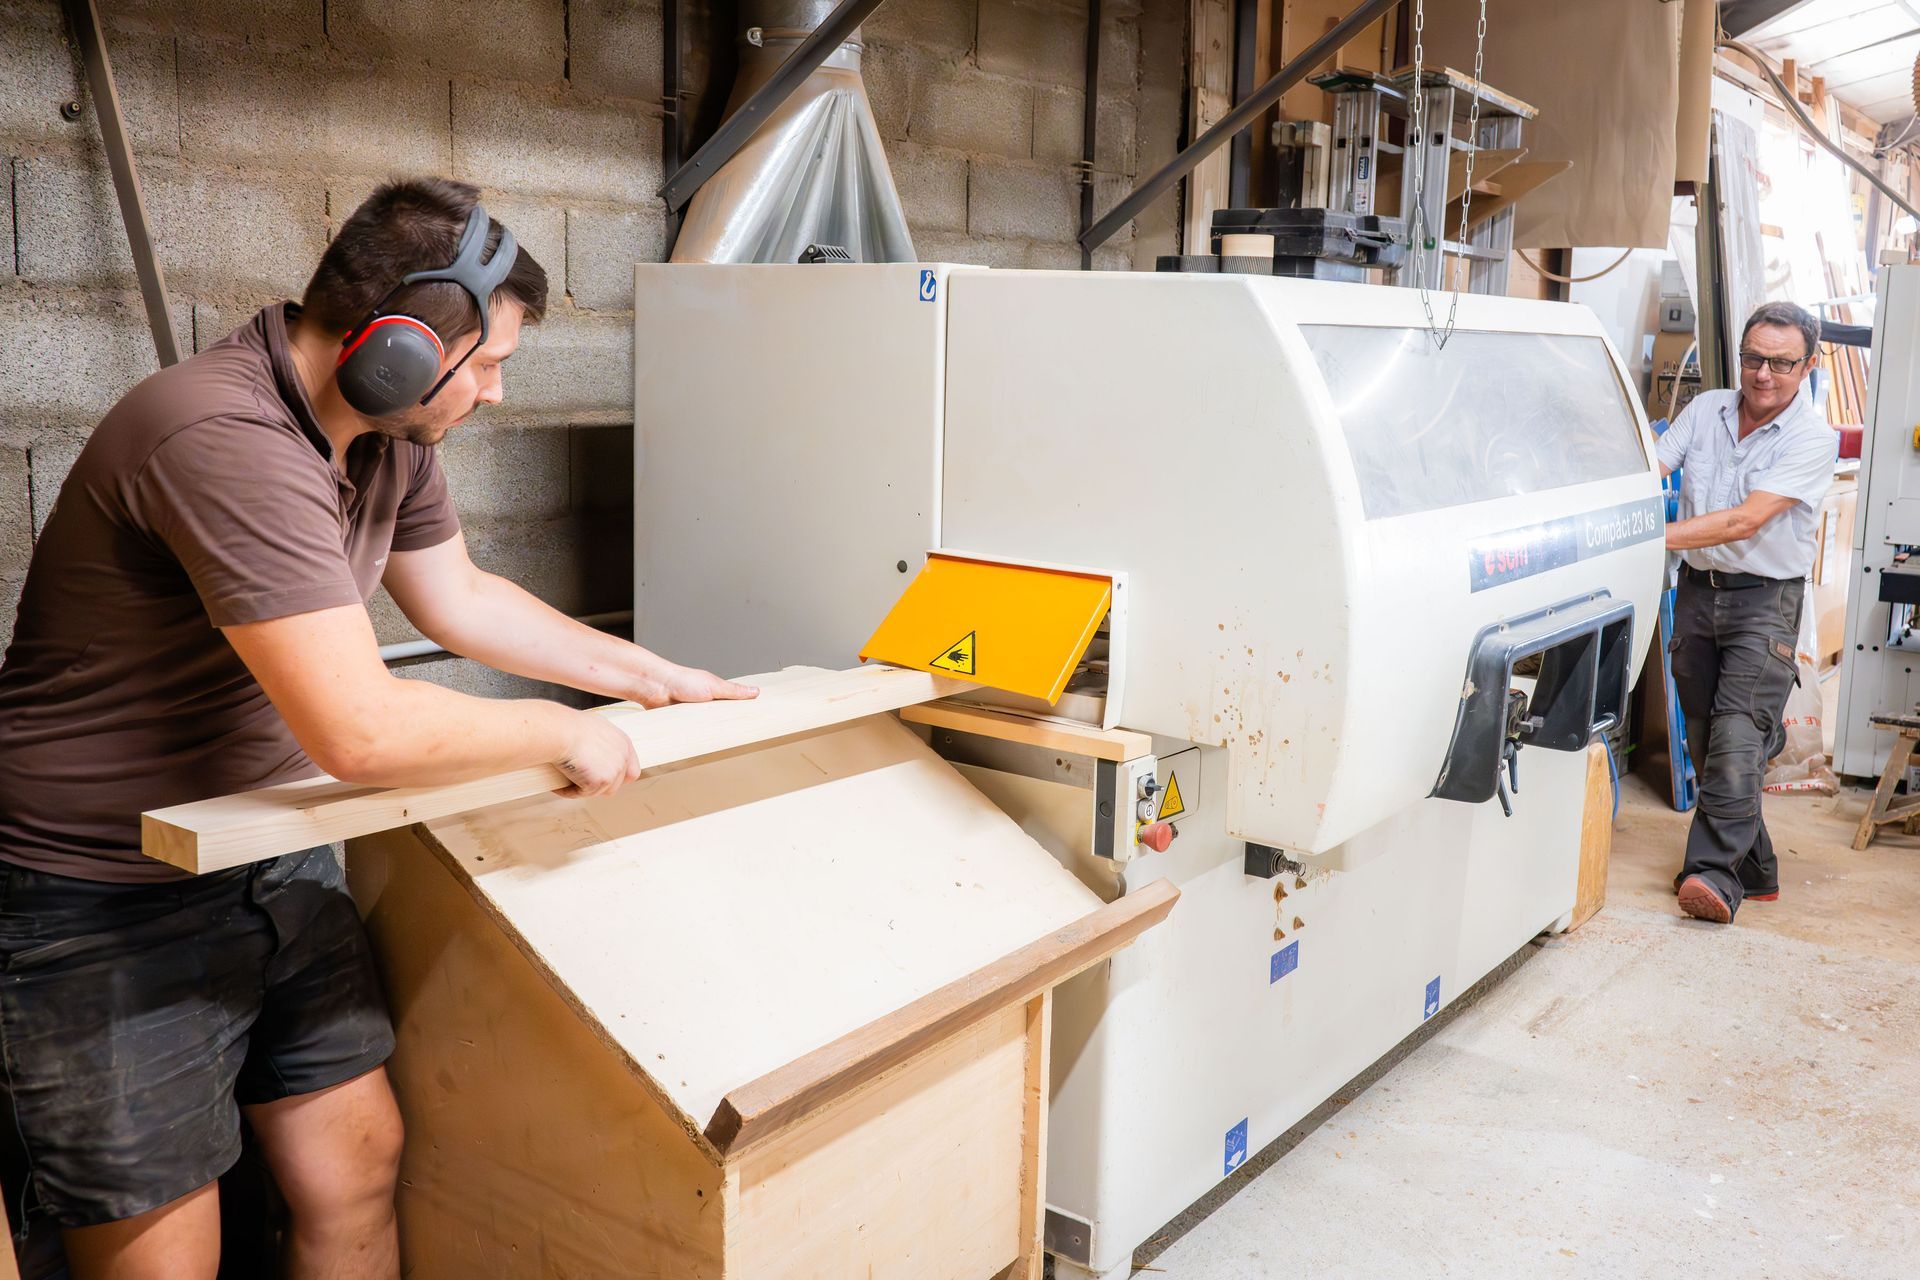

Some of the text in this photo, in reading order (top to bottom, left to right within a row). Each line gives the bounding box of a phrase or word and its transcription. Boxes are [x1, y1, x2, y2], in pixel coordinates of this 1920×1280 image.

[1586, 508, 1656, 549] Compact 23 ks
